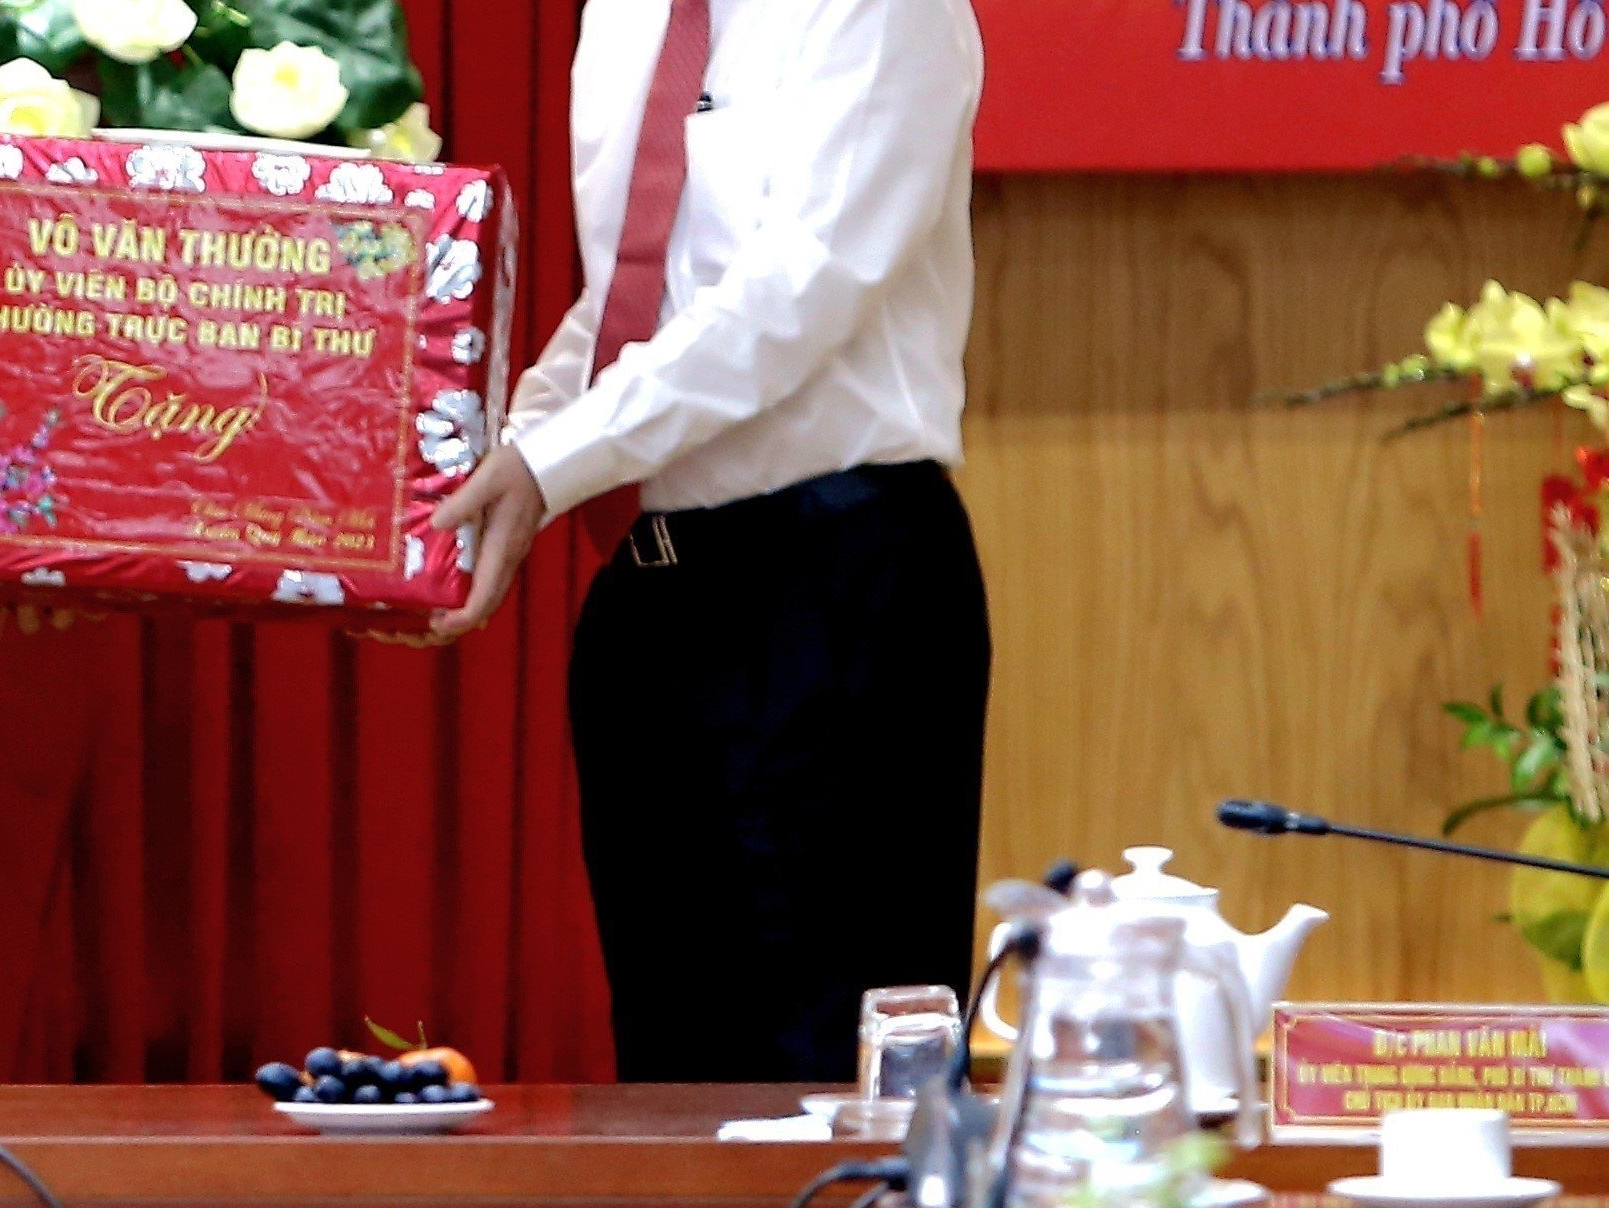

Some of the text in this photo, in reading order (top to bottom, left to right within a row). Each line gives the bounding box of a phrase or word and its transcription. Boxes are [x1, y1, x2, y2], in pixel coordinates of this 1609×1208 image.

[28, 213, 80, 257] VÕ
[91, 220, 166, 263] VĂN
[55, 268, 126, 301] VIÊN
[135, 274, 178, 311] BỘ
[189, 278, 287, 315] CHÍNH
[295, 287, 347, 322] TRỊ
[106, 312, 189, 348] TRỰC
[197, 319, 261, 350] BAN
[312, 326, 377, 359] THƯ
[72, 353, 268, 465] Tặng
